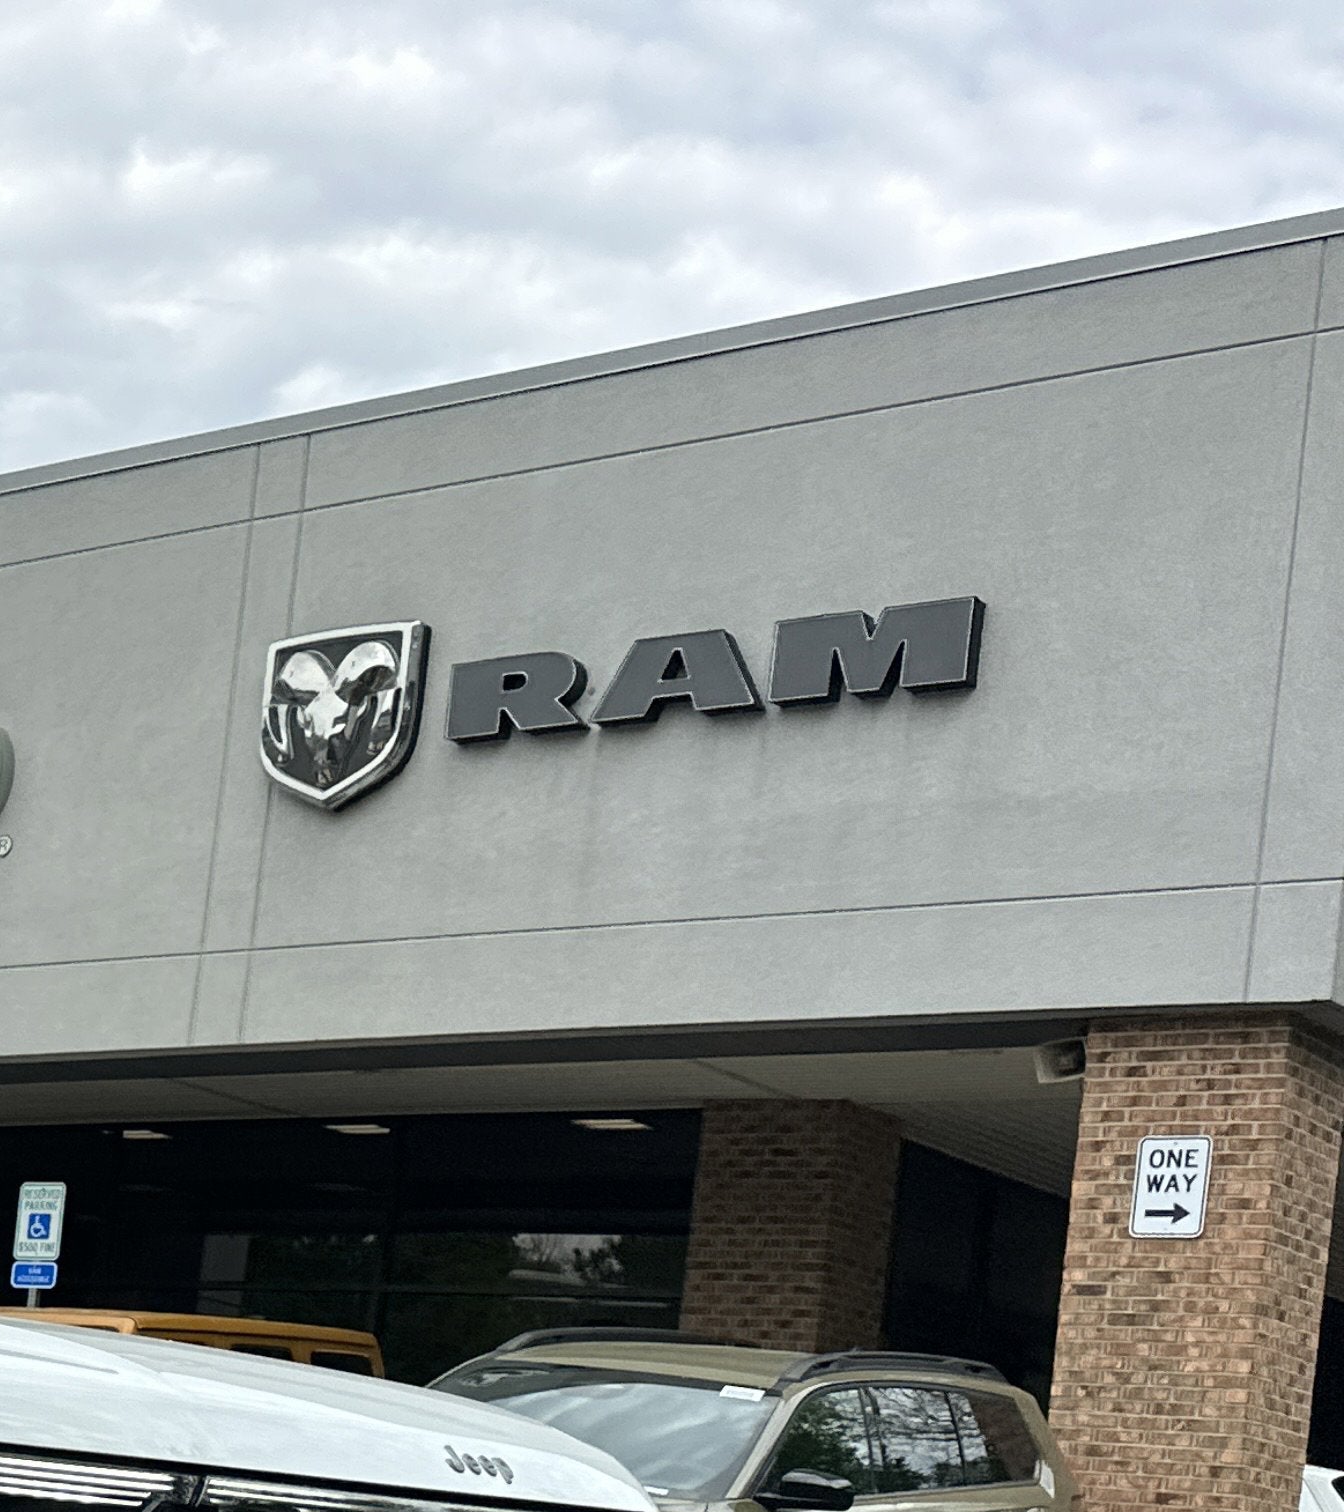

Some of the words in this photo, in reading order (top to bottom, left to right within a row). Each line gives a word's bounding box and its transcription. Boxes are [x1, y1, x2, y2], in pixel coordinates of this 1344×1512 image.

[444, 595, 986, 746] RAM
[1149, 1148, 1200, 1169] ONE
[1146, 1173, 1198, 1194] WAY
[443, 1445, 515, 1485] Jeep
